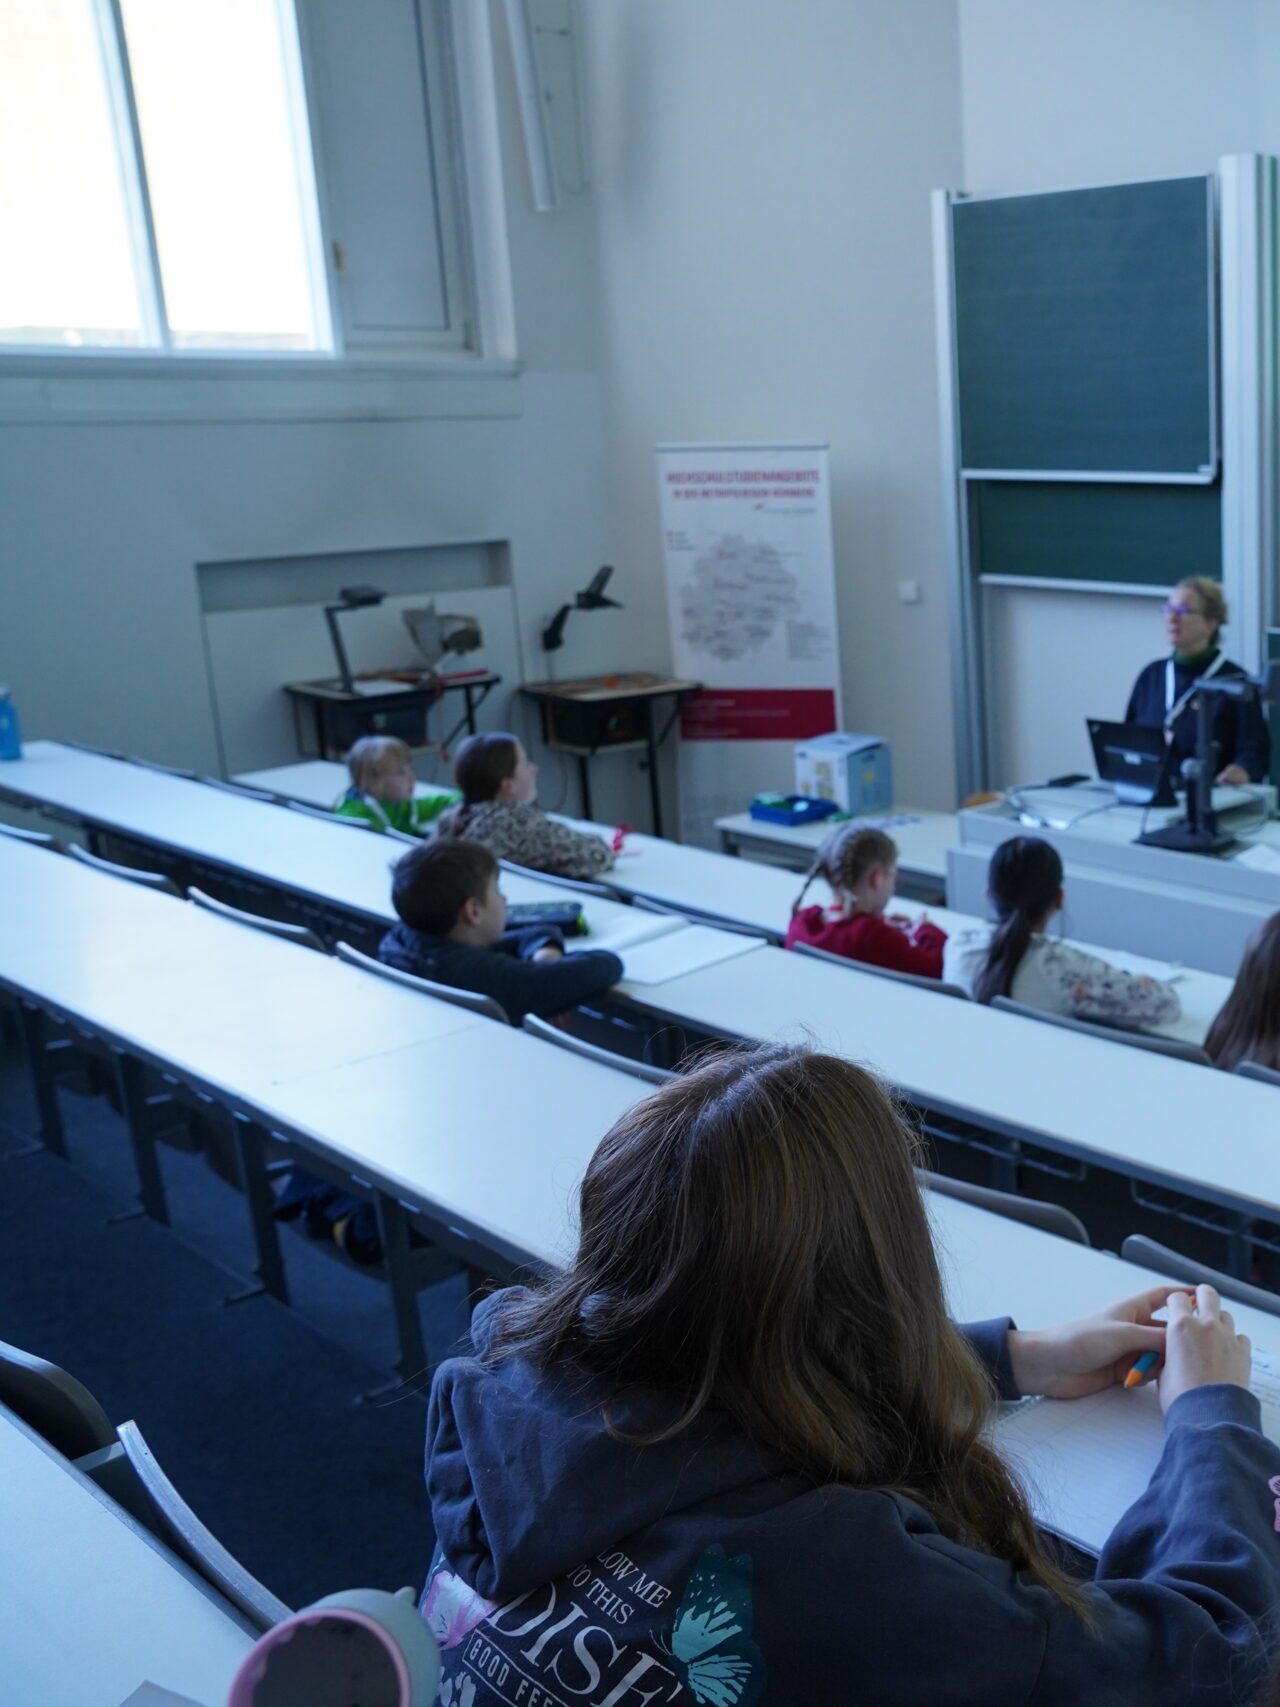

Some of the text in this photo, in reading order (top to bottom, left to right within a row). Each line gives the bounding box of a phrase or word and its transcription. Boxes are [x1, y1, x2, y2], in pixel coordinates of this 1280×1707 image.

[585, 1577, 635, 1624] THIS
[628, 1572, 672, 1608] ME
[469, 1638, 510, 1687] GOOD
